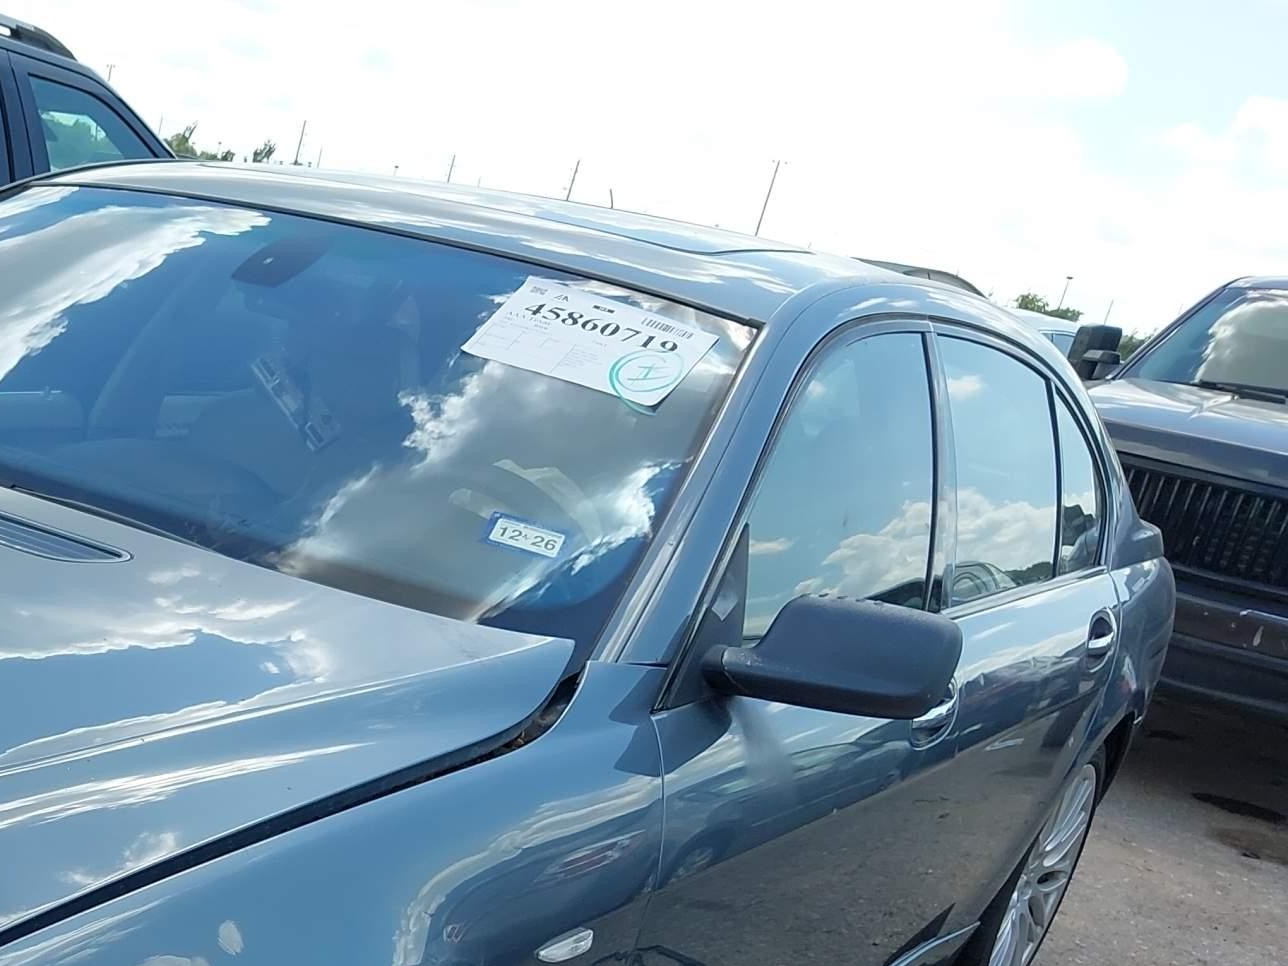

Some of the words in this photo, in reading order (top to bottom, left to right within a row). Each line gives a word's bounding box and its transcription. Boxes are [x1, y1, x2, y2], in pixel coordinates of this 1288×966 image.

[524, 302, 679, 353] 45860719
[499, 526, 523, 541] 12
[530, 535, 558, 551] 26
